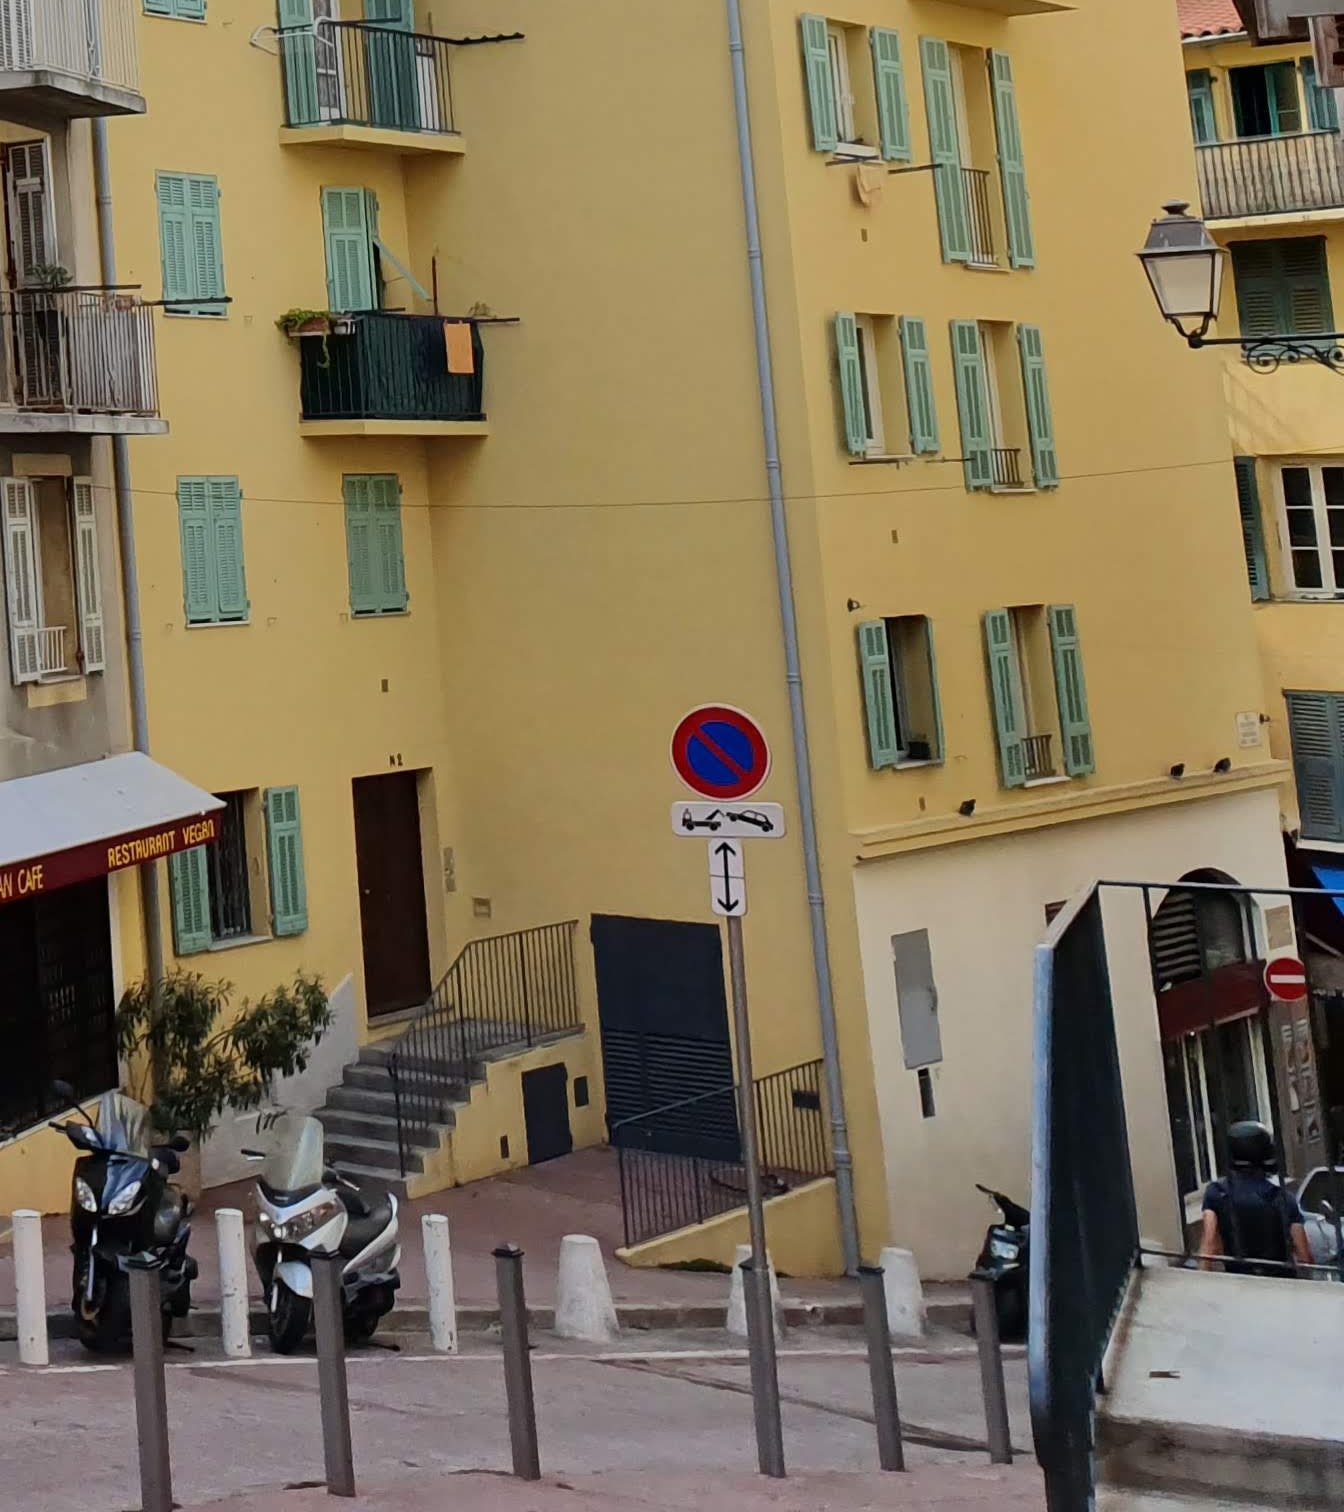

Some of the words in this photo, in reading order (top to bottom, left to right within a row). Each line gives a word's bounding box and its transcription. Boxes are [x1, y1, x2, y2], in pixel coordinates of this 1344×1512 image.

[107, 830, 176, 868] RESTAURANT
[182, 819, 215, 845] VEGAN
[17, 864, 44, 894] CAFE
